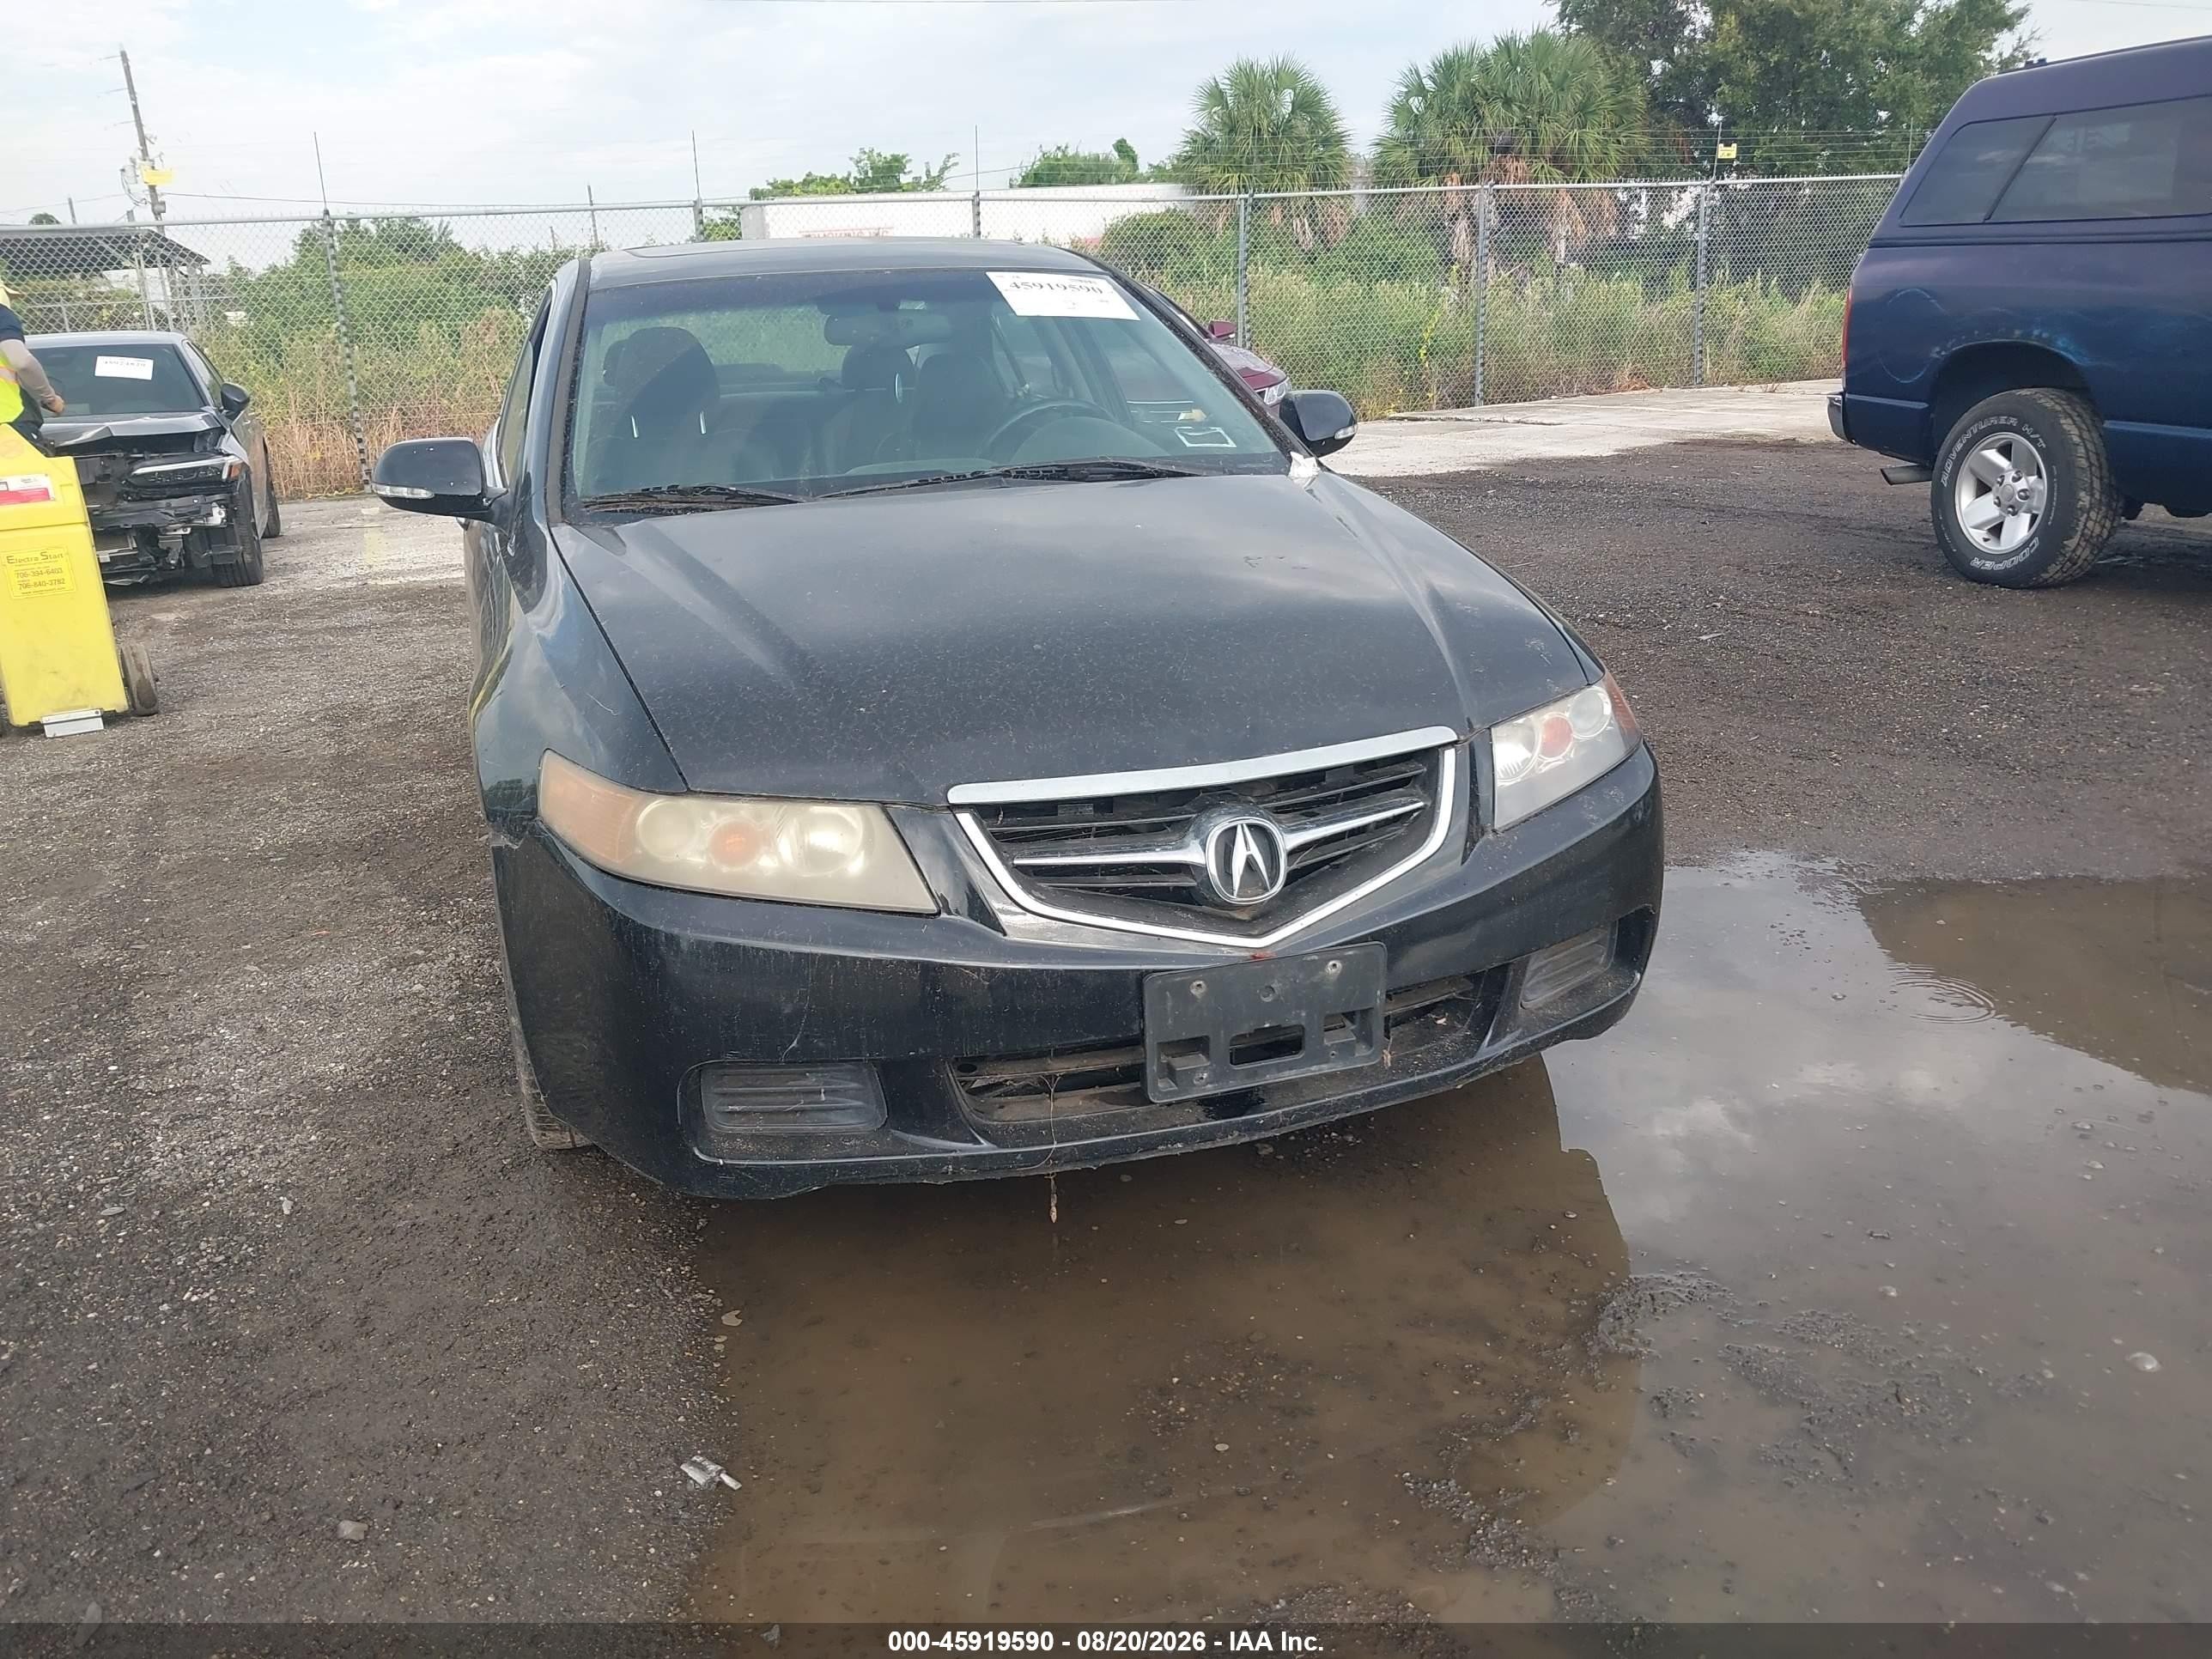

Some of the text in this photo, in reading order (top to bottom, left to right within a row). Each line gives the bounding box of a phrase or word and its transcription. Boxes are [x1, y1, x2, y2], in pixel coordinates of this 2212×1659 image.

[1009, 281, 1103, 295] 45919590
[1941, 416, 2019, 488] ADVENTURER
[40, 550, 64, 561] Start
[1970, 536, 2039, 571] COOPER
